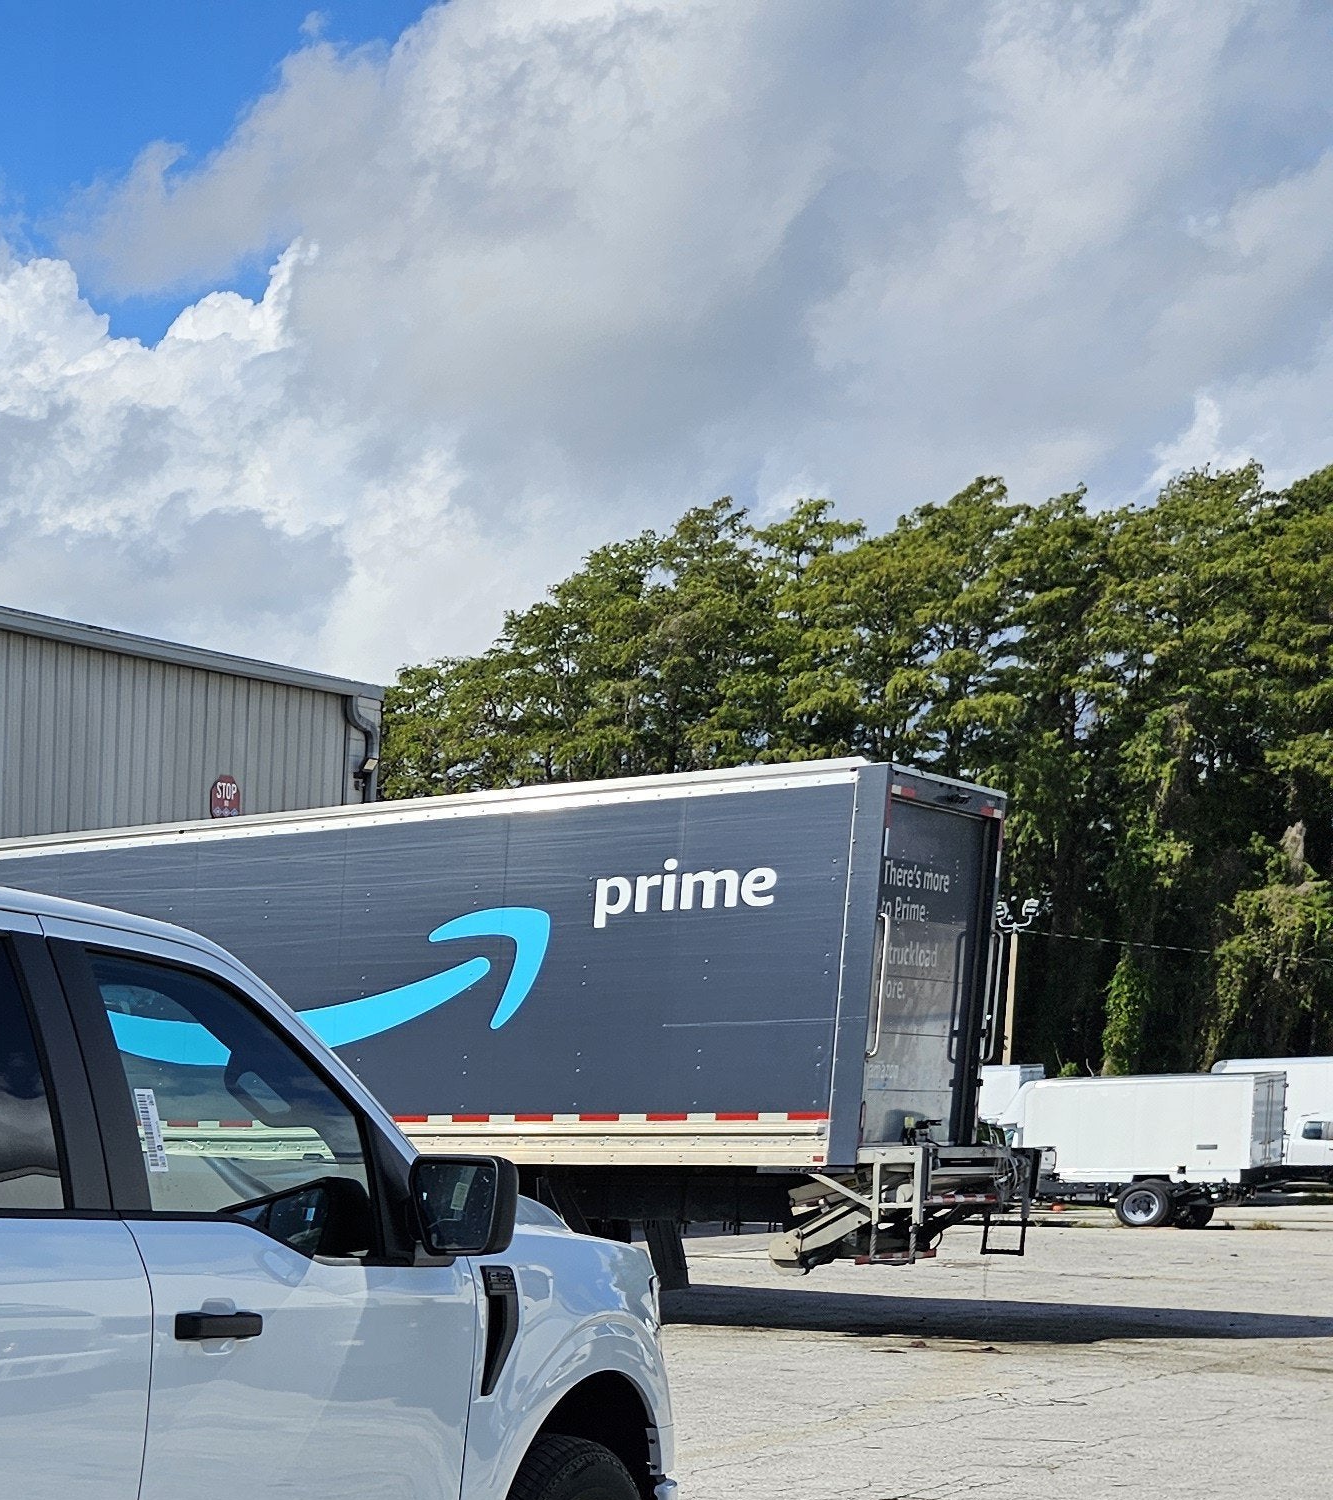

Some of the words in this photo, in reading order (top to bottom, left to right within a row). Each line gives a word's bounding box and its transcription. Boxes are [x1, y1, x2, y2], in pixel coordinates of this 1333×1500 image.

[216, 781, 237, 800] STOP
[883, 859, 922, 889] There's
[922, 870, 950, 893] more
[593, 857, 778, 929] prime
[888, 940, 938, 968] truckload
